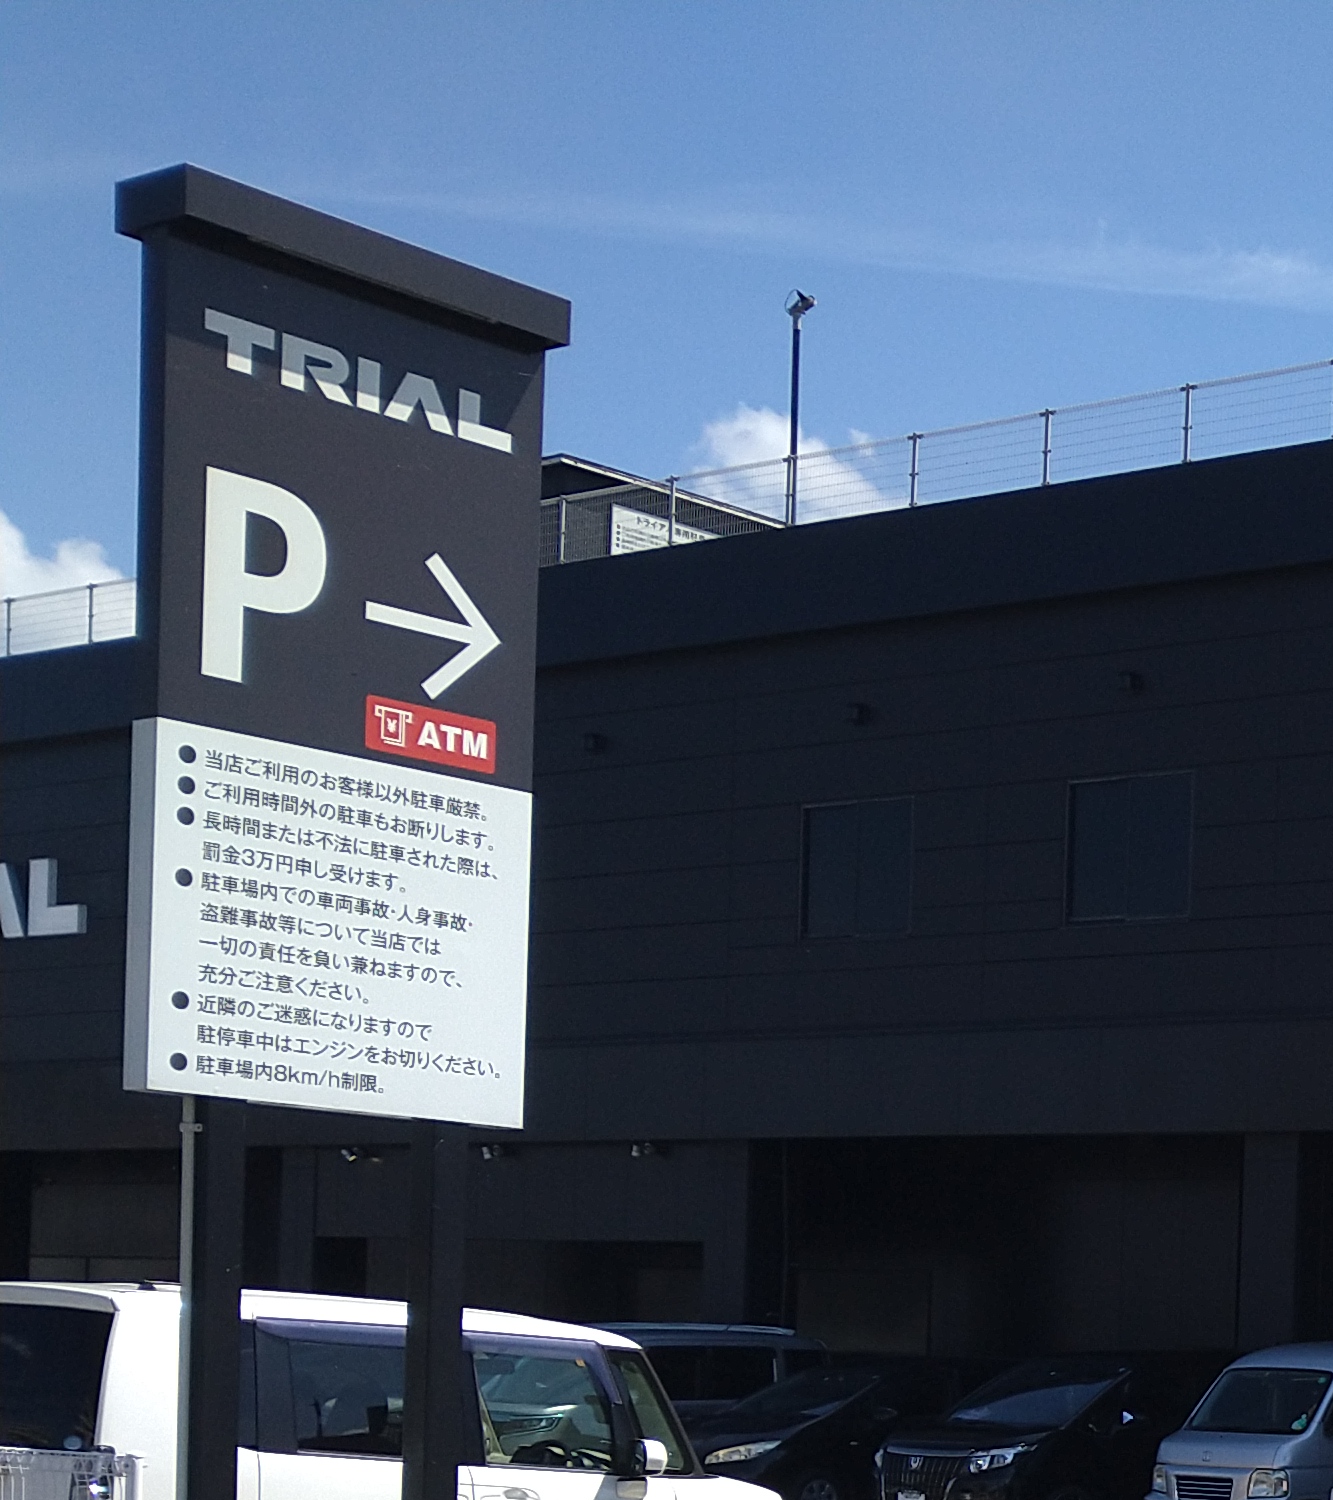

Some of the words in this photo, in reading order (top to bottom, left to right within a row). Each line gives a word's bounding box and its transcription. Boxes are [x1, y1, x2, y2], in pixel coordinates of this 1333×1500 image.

[205, 307, 512, 454] TRIAL
[200, 465, 327, 683] P
[417, 718, 489, 761] ATM
